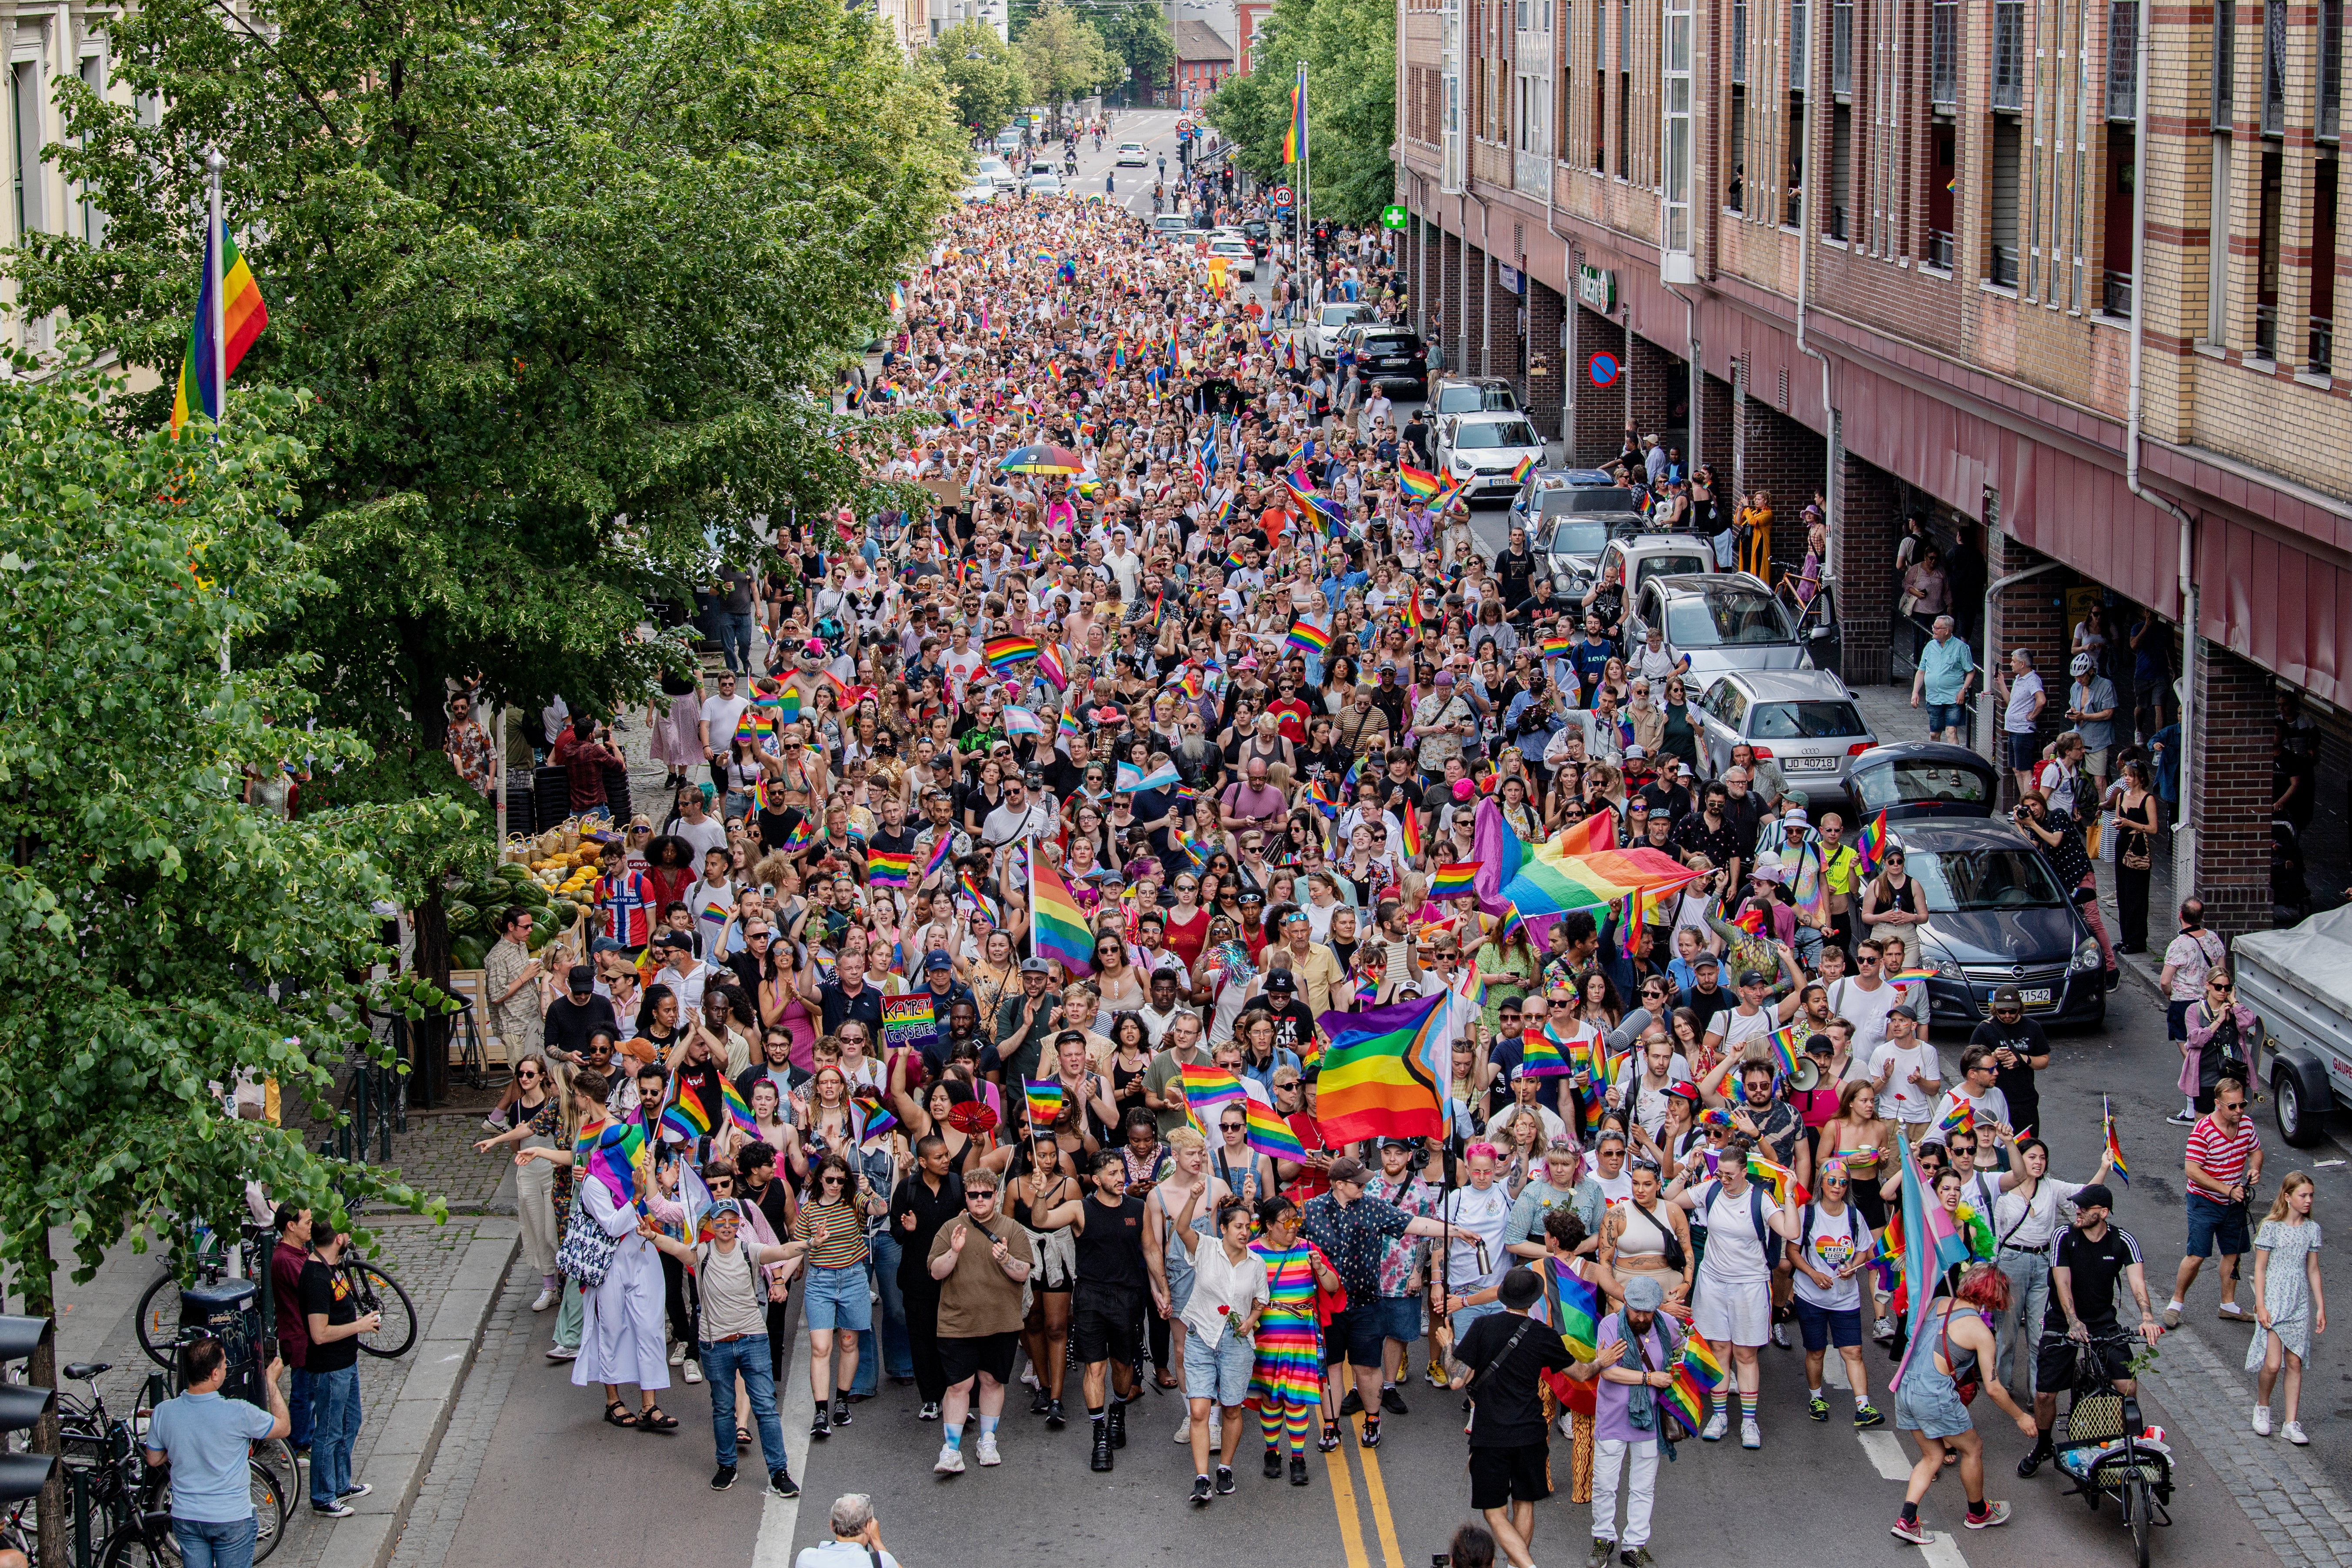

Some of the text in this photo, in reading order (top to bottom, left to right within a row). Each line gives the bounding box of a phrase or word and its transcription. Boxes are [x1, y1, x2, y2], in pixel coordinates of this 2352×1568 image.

[1277, 193, 1290, 201] 40
[1579, 264, 1599, 306] brilleland
[1788, 758, 1832, 767] JD 40718
[881, 997, 931, 1021] KAMPEN
[885, 1021, 937, 1043] FORTSETTER
